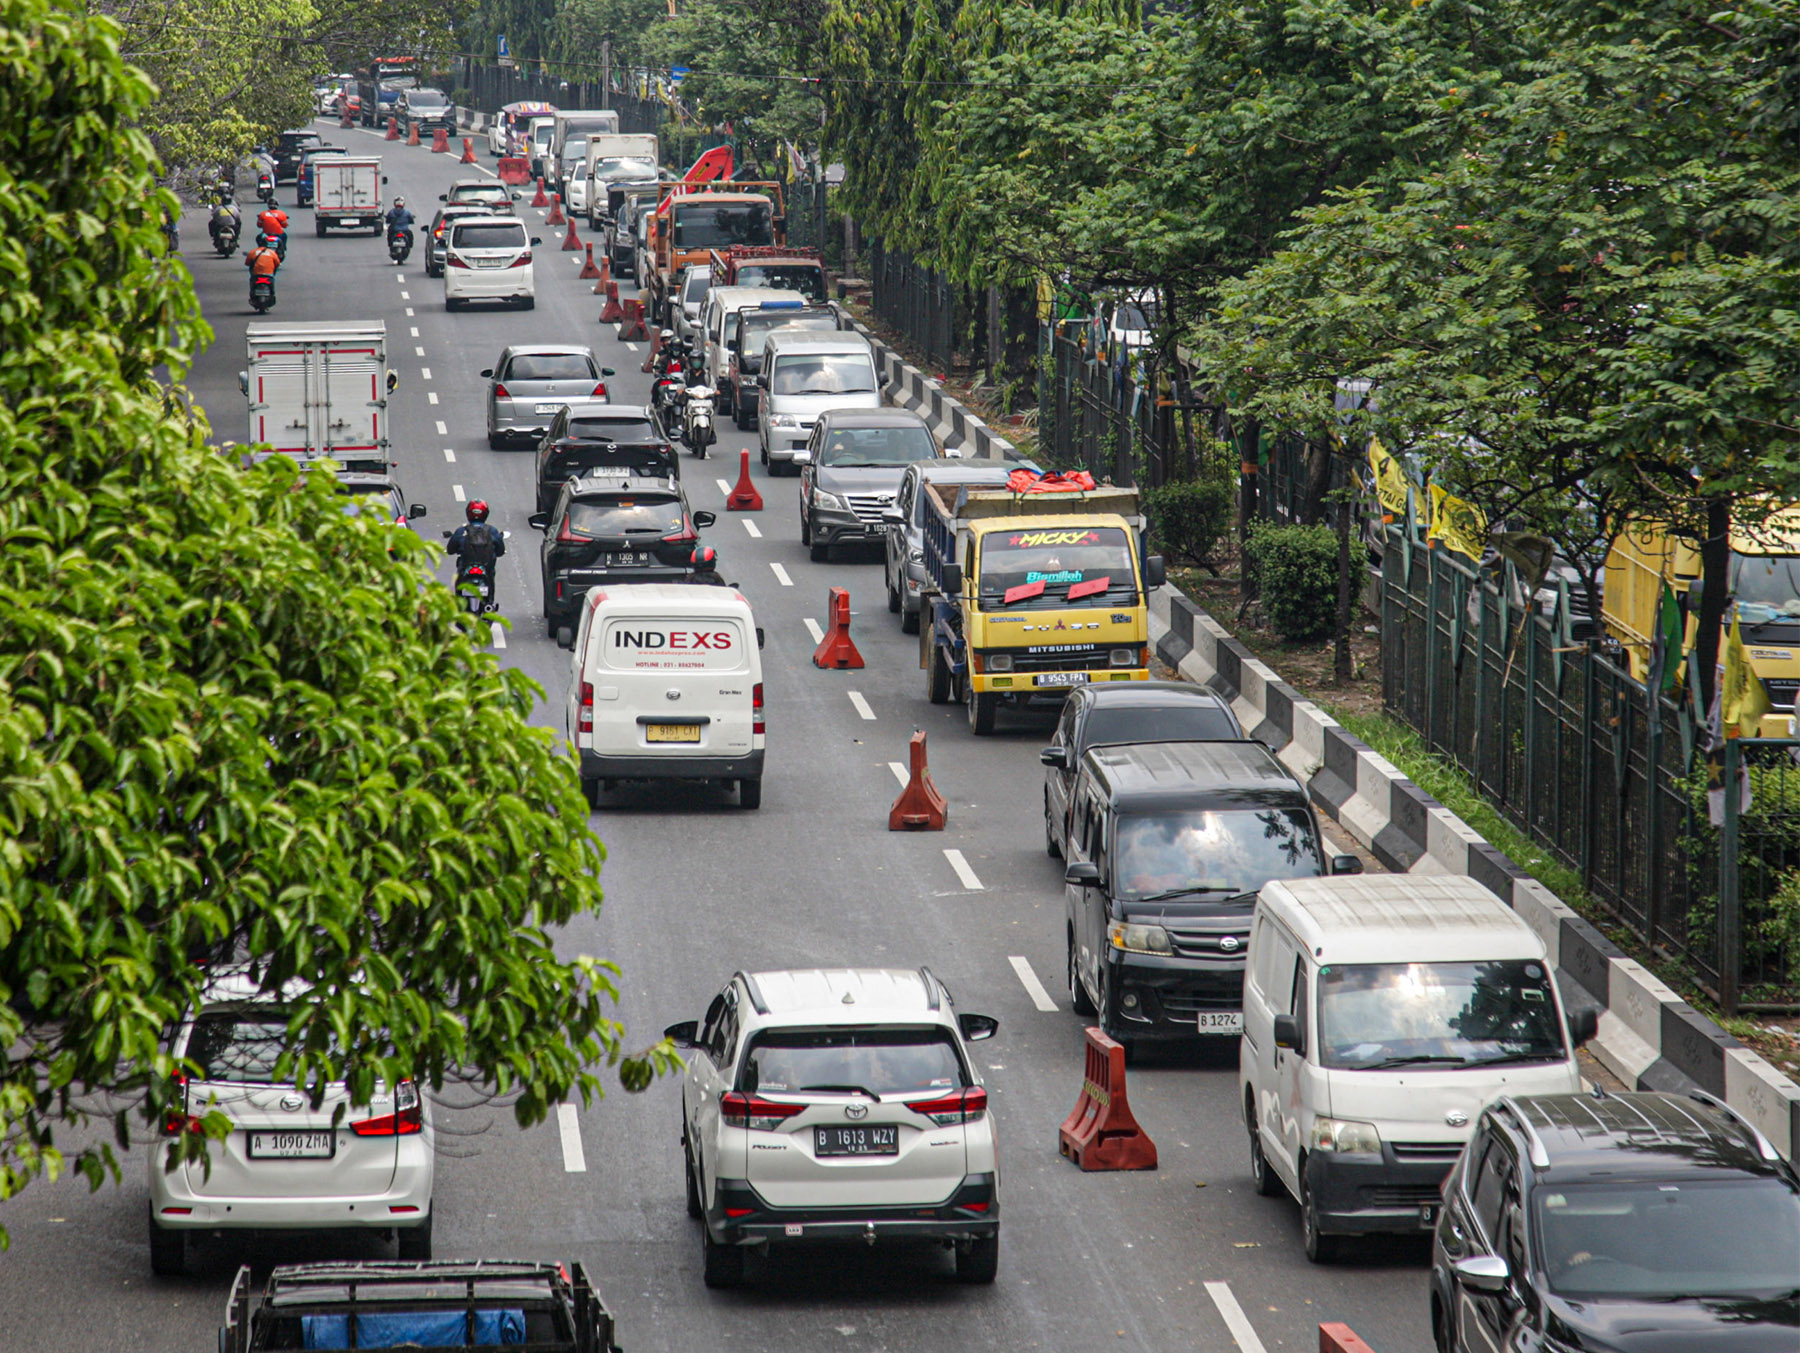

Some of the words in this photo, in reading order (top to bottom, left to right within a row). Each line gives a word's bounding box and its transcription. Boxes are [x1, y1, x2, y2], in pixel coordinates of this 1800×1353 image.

[1379, 457, 1390, 477] 4
[1019, 531, 1088, 547] MICKY
[619, 553, 633, 561] 1305
[639, 553, 648, 561] NR
[615, 631, 732, 650] INDEXS
[1028, 643, 1095, 653] MITSUBISHI
[1201, 1015, 1207, 1026] B
[254, 1136, 261, 1149] A
[272, 1135, 303, 1149] 1090
[305, 1134, 329, 1149] ZMA
[819, 1131, 827, 1145] B
[837, 1130, 865, 1145] 1613
[872, 1129, 895, 1144] WZY
